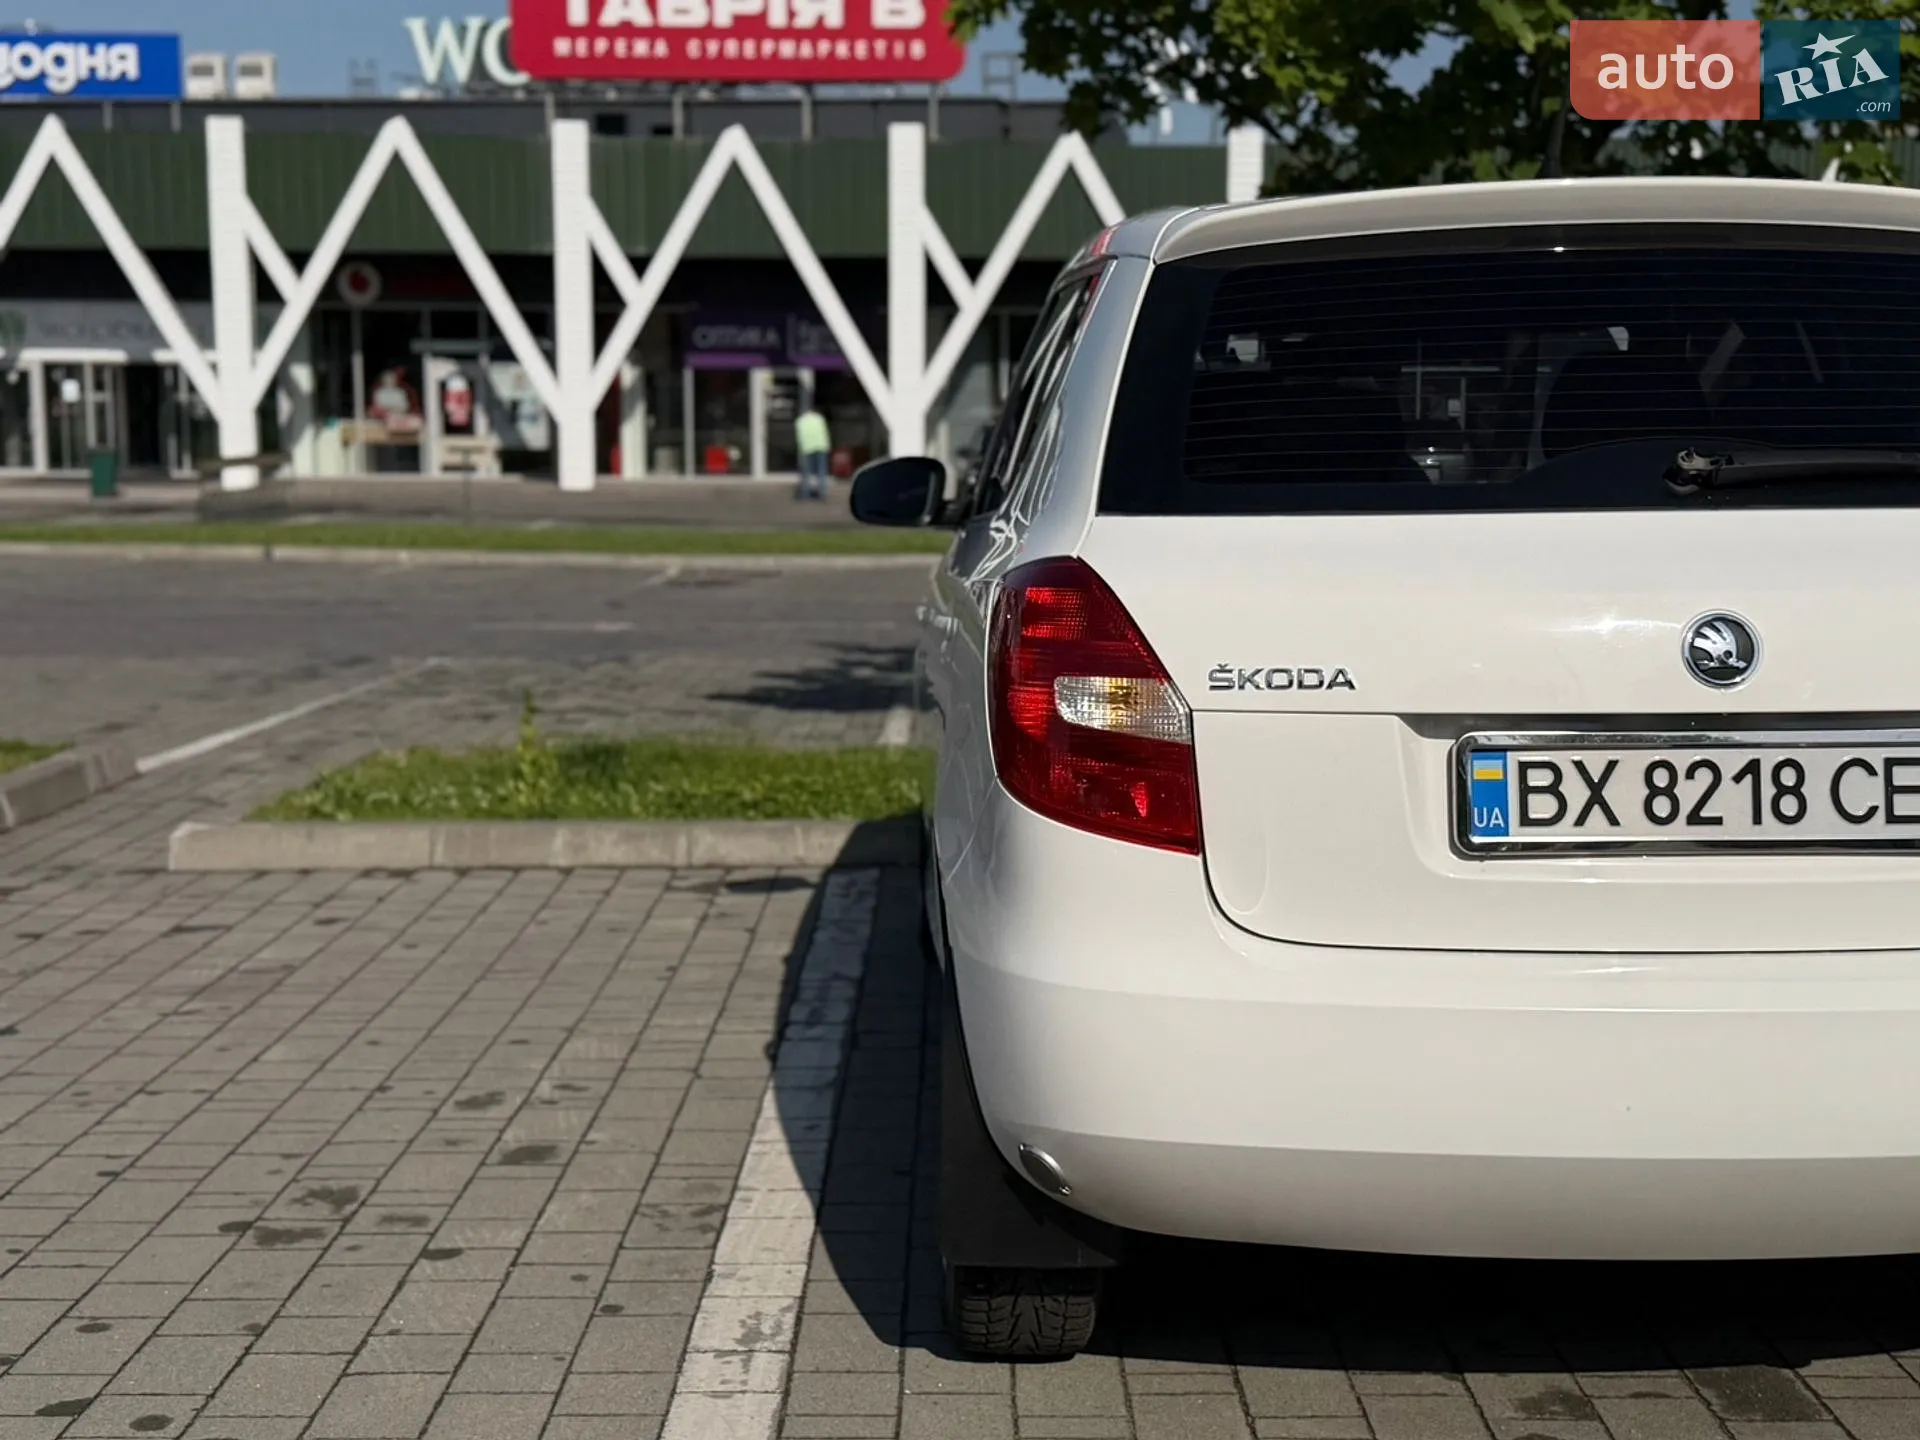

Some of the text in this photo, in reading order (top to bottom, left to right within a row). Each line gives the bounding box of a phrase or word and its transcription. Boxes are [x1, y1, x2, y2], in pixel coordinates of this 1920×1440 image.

[553, 36, 927, 61] МЕРЕЖА СУПЕРМАРКЕТІВ
[1208, 663, 1356, 691] ŠKODA
[1517, 757, 1622, 828] BX
[1643, 756, 1808, 826] 8218
[1474, 807, 1505, 828] UA
